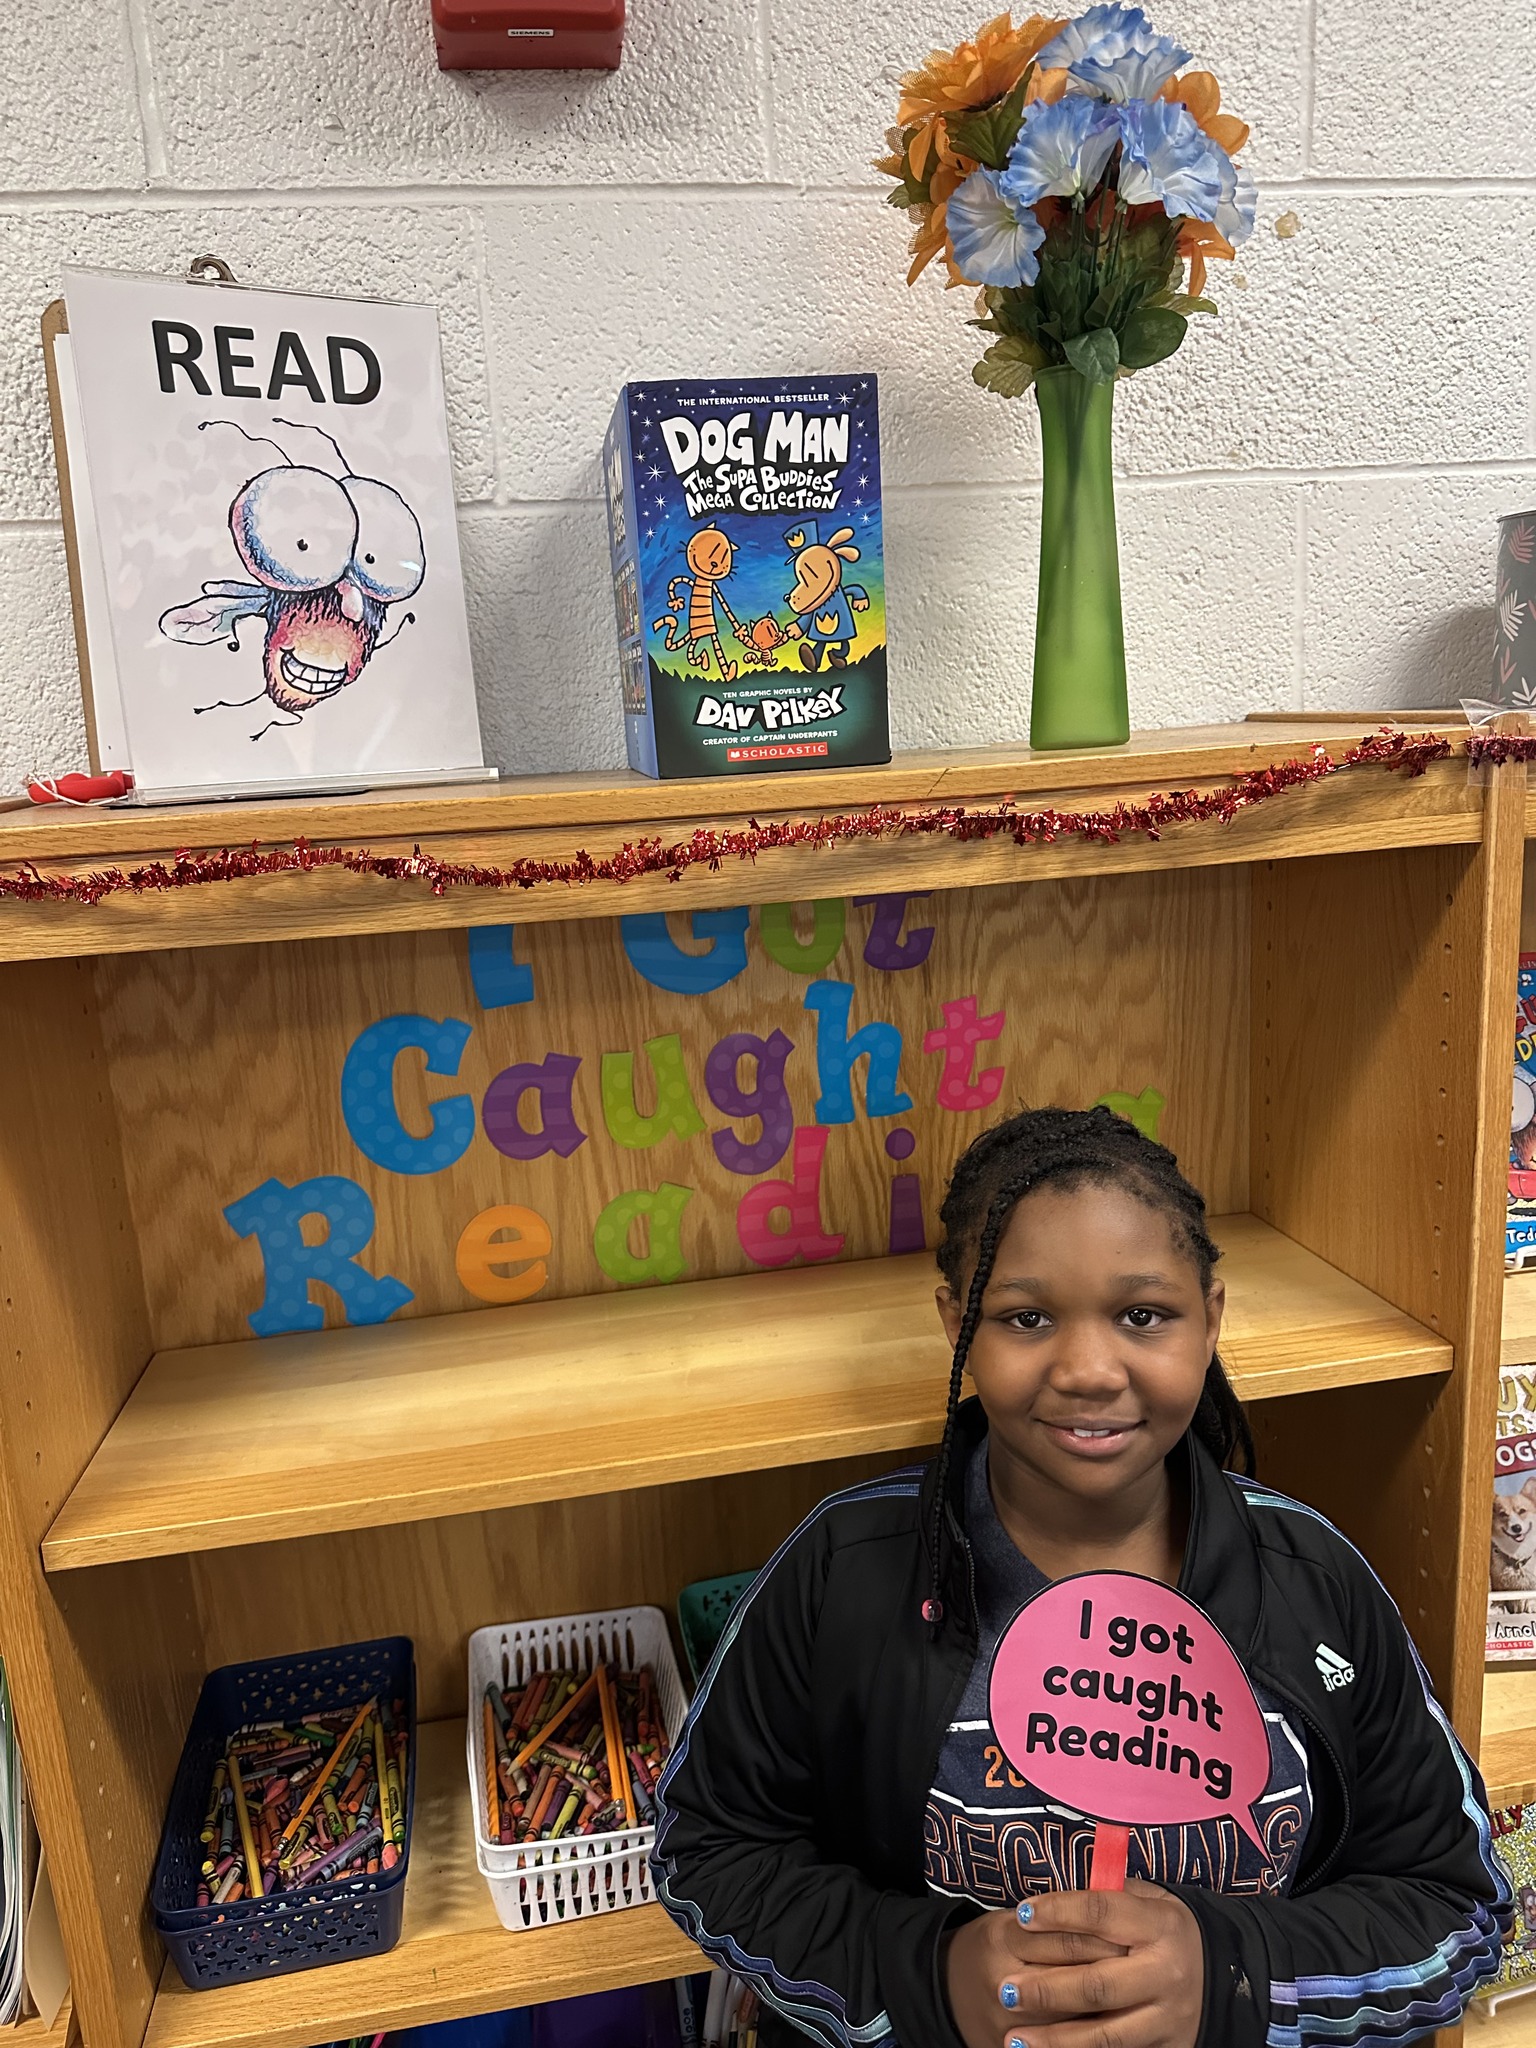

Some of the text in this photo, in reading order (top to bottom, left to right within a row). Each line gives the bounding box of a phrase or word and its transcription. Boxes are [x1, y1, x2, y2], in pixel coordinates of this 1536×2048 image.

[152, 320, 381, 405] READ
[677, 393, 830, 407] THE INTERNATIONAL BESTSELLER
[660, 411, 849, 475] DOG MAN
[696, 697, 755, 731] DAV
[723, 691, 737, 699] TEN
[739, 689, 772, 697] GRAPHIC
[773, 688, 801, 696] NOVELS
[703, 730, 838, 746] CREATOR OF CAPTAIN UNDERPANTS
[742, 745, 825, 758] SCHOLASTIC
[620, 891, 935, 996] Got
[340, 979, 1006, 1175] Caught
[222, 1086, 1166, 1337] Readi
[1506, 1226, 1536, 1244] Ted
[1080, 1599, 1195, 1664] I got
[1043, 1666, 1223, 1732] caught
[1026, 1713, 1232, 1800] Reading
